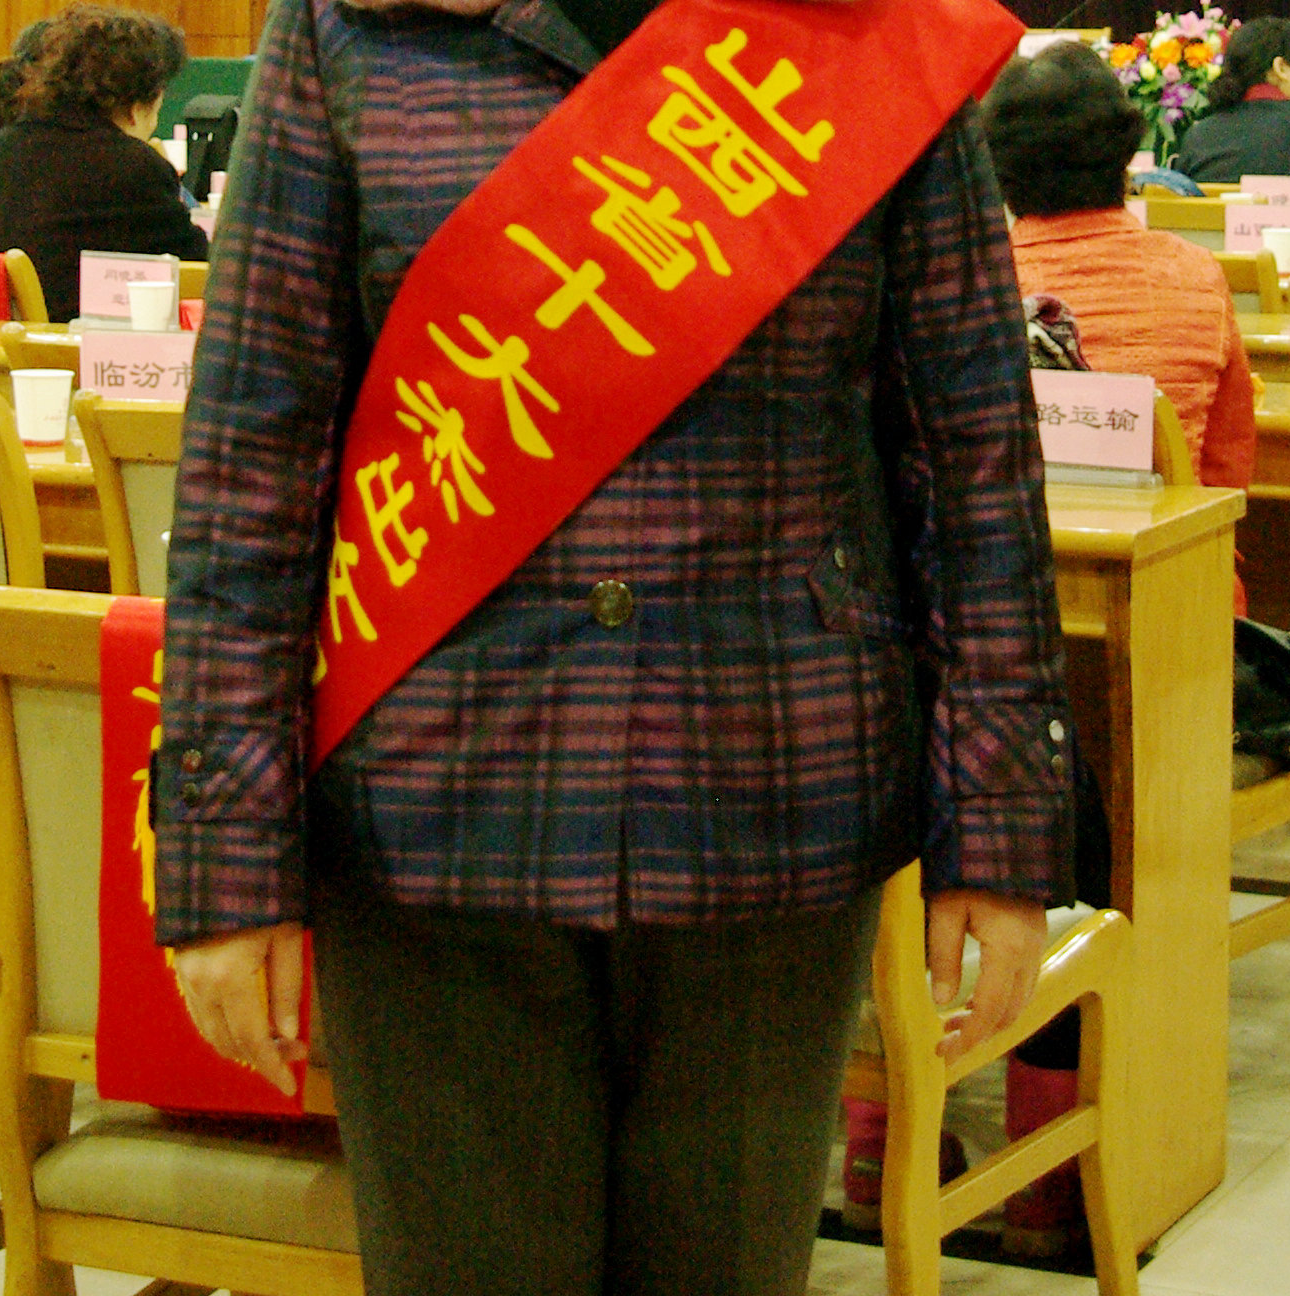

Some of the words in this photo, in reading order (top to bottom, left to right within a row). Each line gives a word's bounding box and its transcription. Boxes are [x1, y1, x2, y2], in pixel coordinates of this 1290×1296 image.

[93, 360, 192, 390] 临汾市
[312, 26, 836, 685] 山西省十大杰出女
